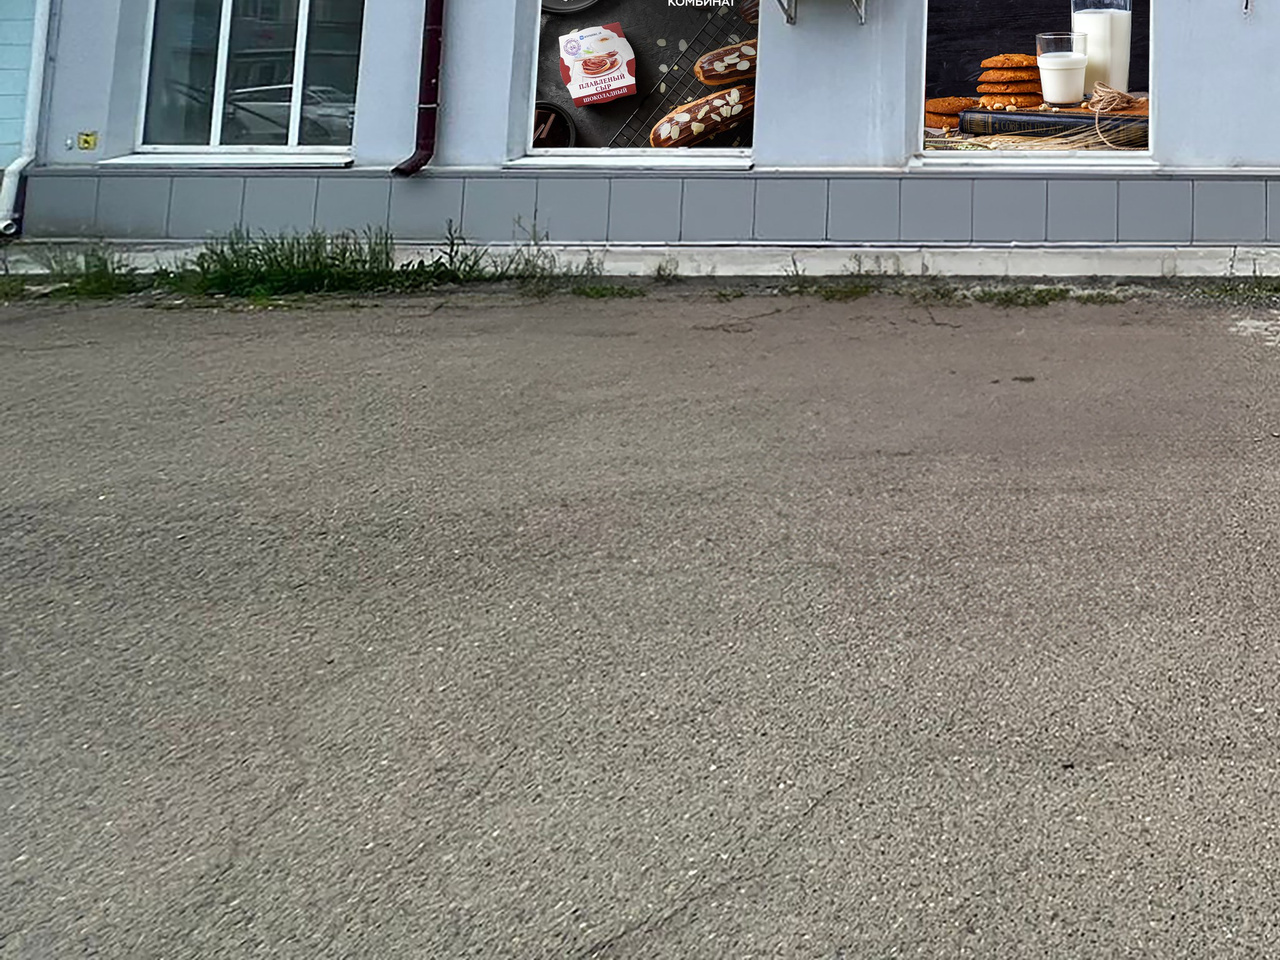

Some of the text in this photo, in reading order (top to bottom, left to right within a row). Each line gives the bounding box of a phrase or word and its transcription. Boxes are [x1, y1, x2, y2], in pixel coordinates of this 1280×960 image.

[578, 72, 626, 91] ПЛАВЛЕНЫЙ
[595, 83, 612, 93] СЫР
[583, 87, 628, 103] ШОКОЛАДНЫЙ
